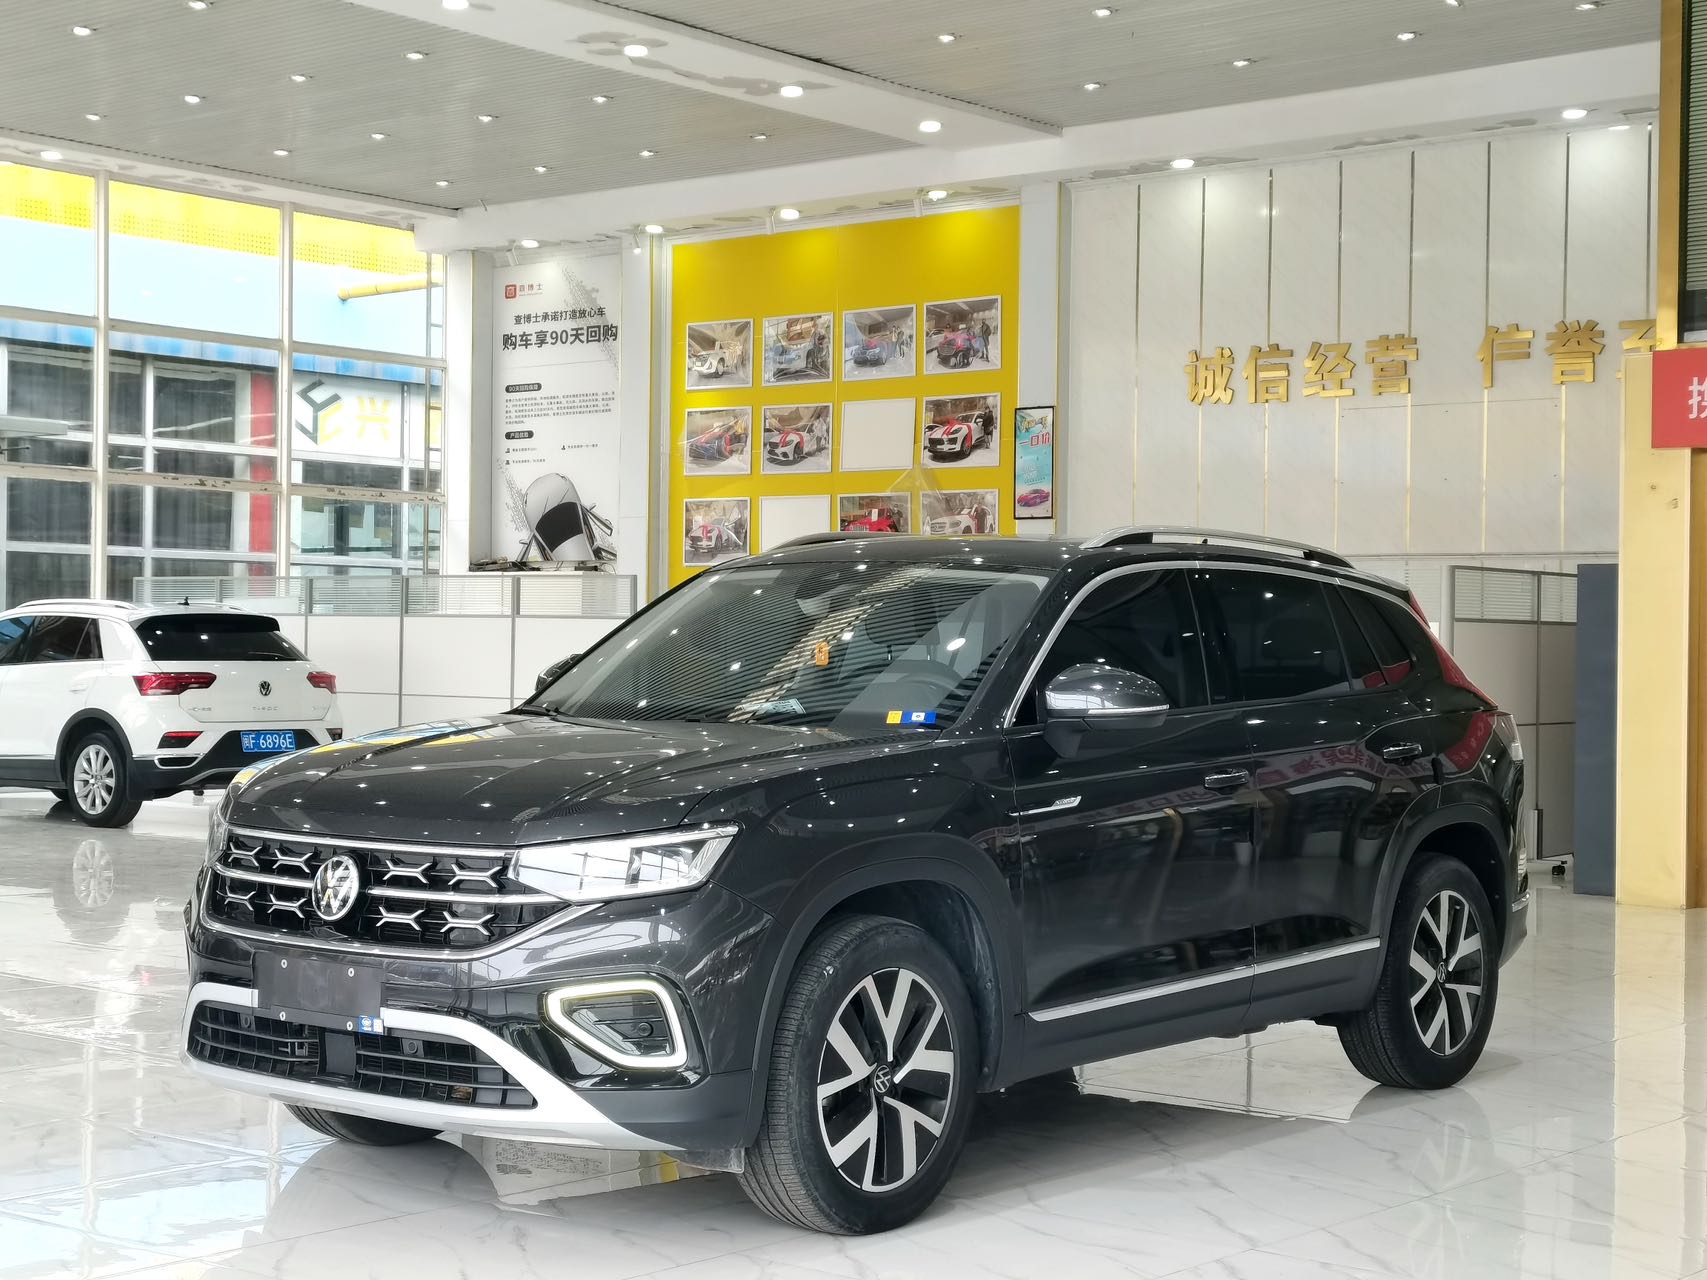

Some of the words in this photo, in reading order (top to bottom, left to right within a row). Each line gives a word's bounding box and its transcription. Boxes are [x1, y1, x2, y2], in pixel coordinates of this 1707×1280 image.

[513, 306, 606, 325] 查博士承诺打造放心车
[502, 323, 618, 350] 购车享90天回购
[1184, 333, 1419, 406] 诚信经营
